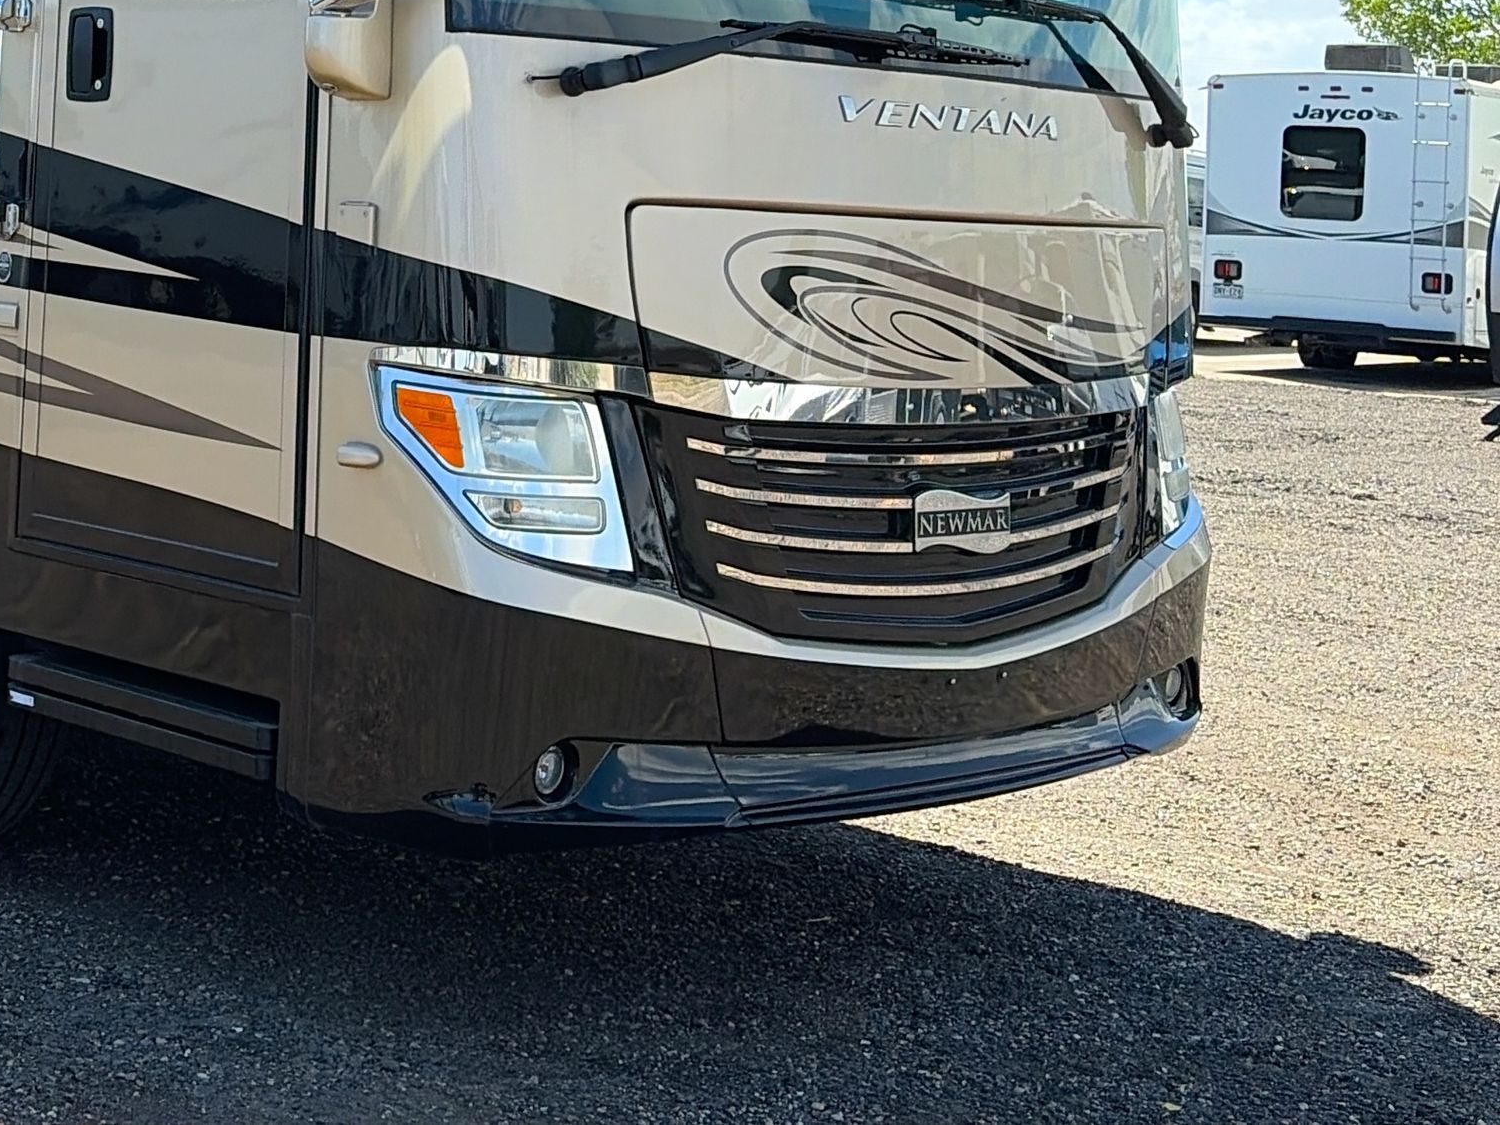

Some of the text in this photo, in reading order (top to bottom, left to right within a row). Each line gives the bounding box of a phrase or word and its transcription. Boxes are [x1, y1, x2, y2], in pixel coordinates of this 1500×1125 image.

[837, 95, 1059, 141] VENTANA
[1293, 104, 1374, 123] Jayco
[919, 509, 1009, 536] NEWMAR
